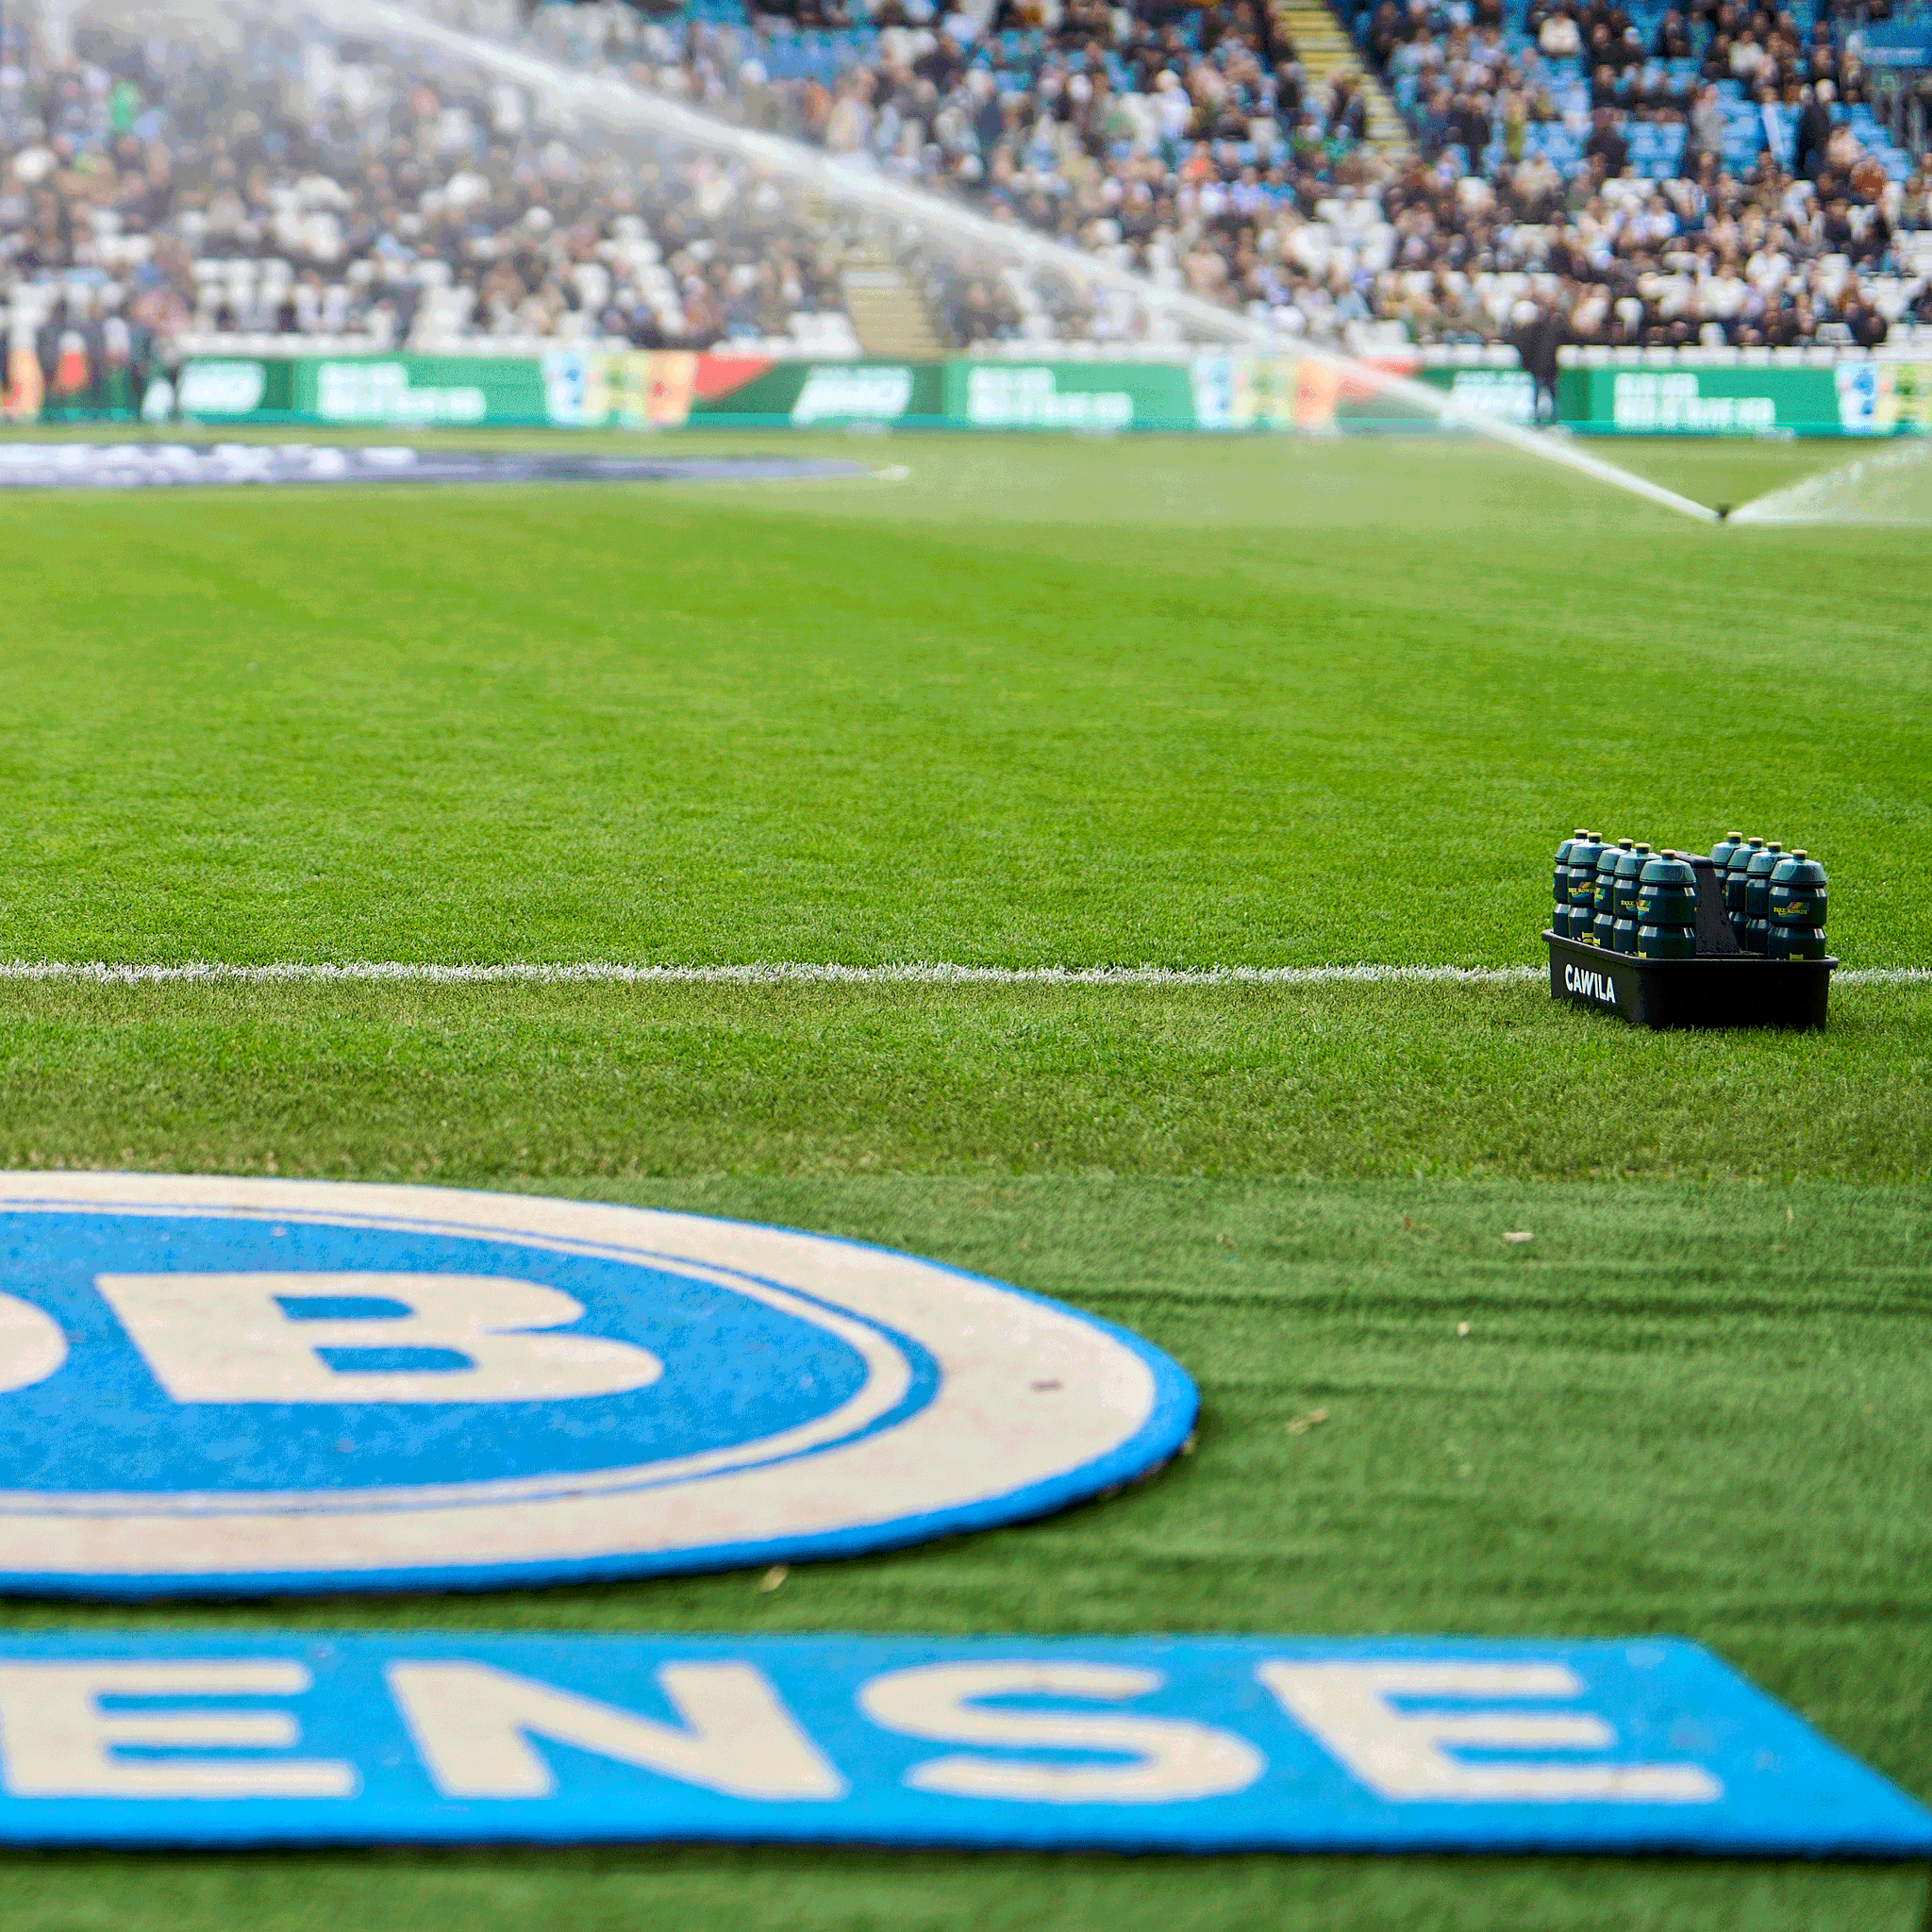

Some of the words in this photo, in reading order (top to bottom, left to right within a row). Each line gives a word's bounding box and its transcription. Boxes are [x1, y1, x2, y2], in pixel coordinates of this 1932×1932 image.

[1565, 963, 1616, 1004] CAWILA
[0, 1272, 664, 1404] B
[0, 1660, 1720, 1802] ENSE
